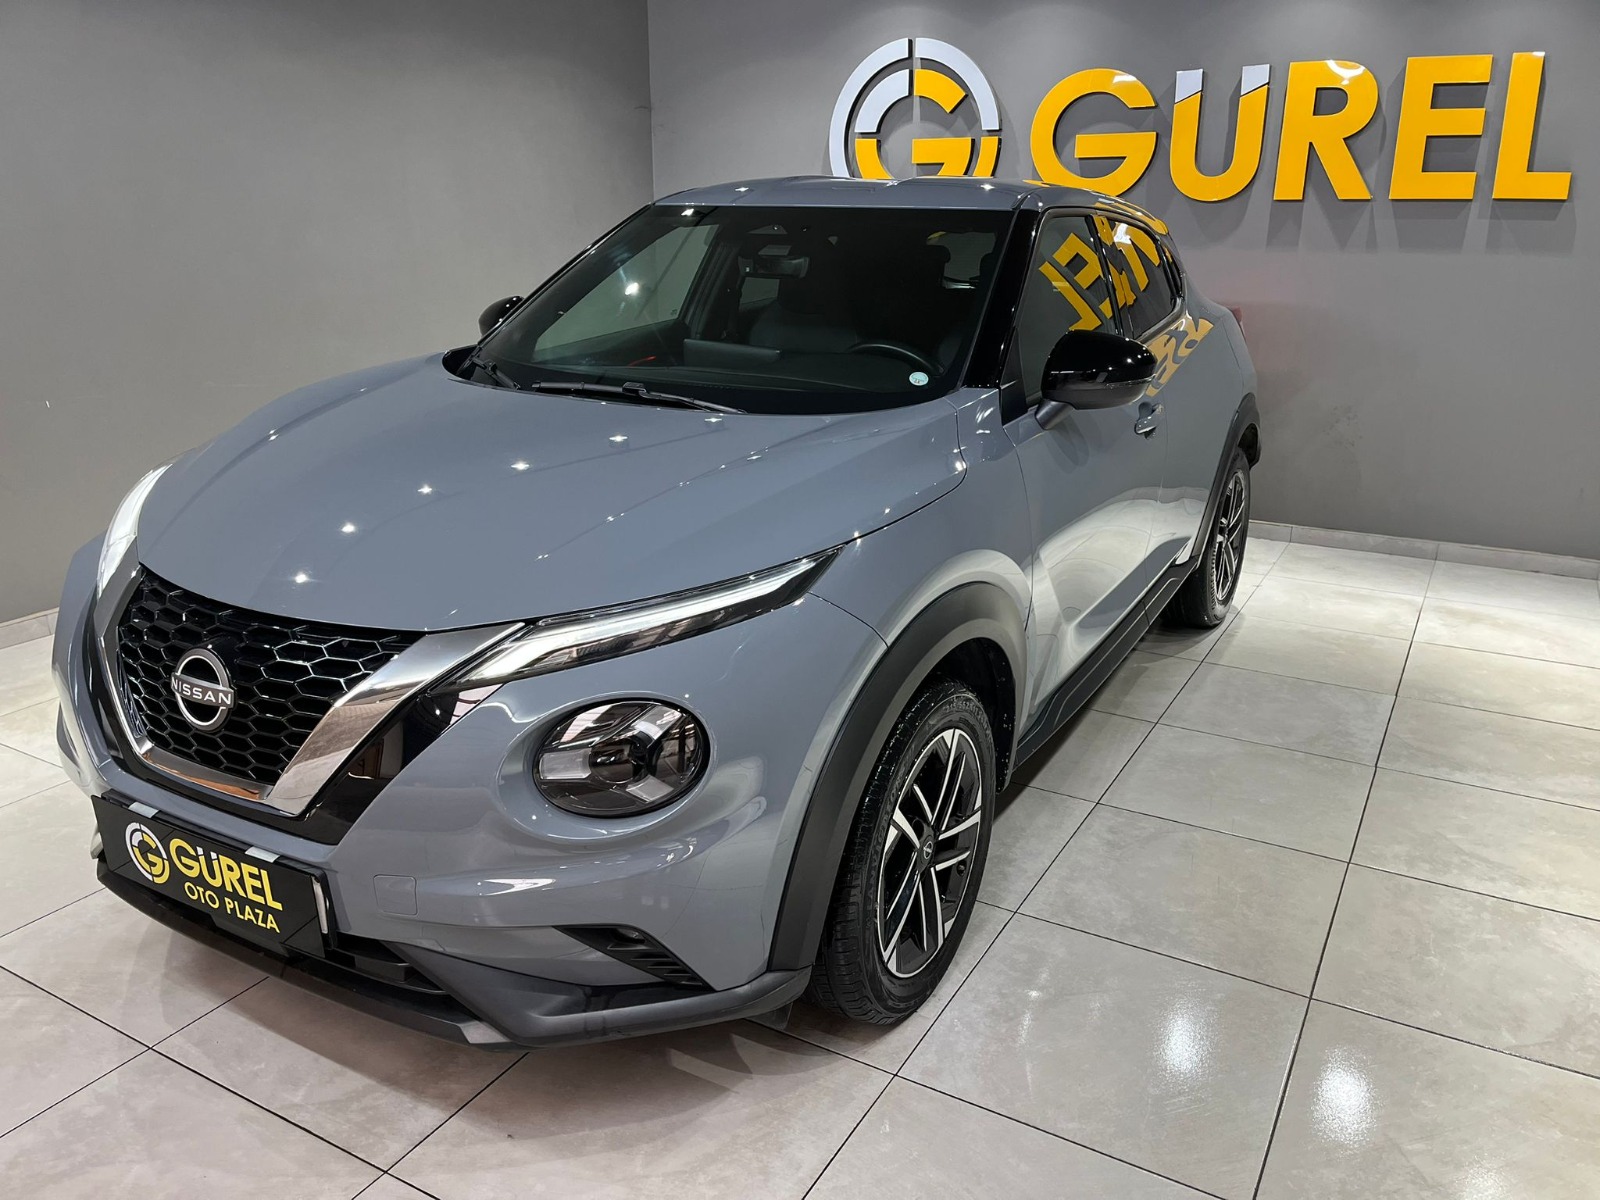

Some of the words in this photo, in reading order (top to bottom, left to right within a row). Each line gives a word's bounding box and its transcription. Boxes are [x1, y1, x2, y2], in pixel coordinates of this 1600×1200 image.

[171, 676, 231, 705] NISSAN
[184, 882, 220, 909] OTO
[224, 897, 280, 934] PLAZA
